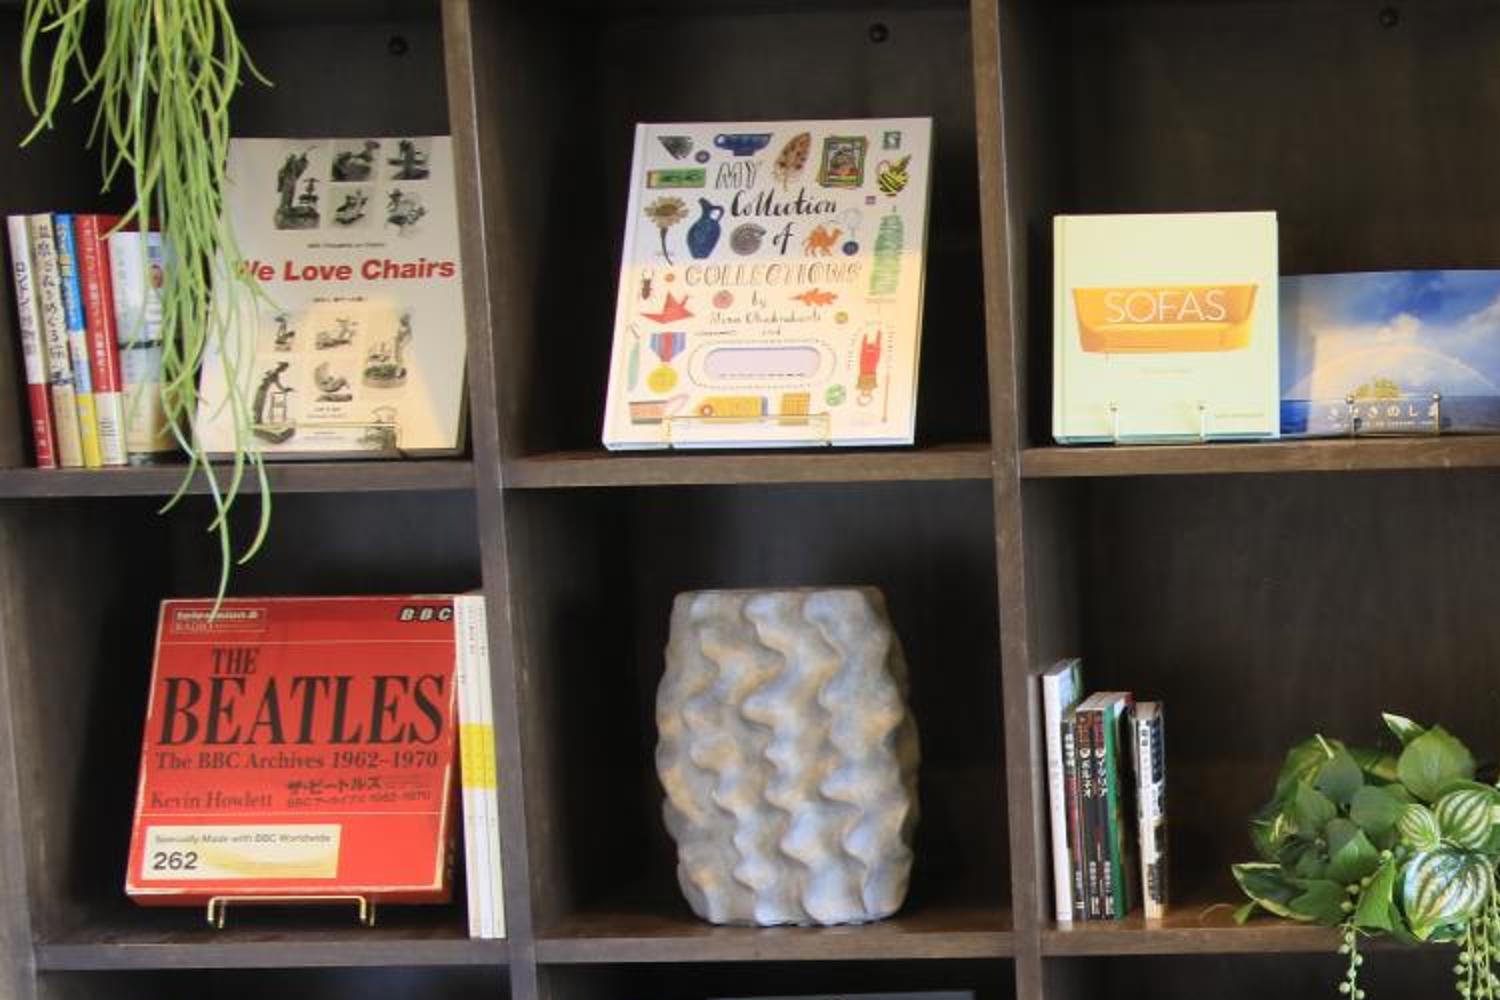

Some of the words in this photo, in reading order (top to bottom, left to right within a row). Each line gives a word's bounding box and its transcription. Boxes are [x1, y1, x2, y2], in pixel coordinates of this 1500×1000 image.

[715, 161, 760, 189] MY
[731, 188, 837, 217] Collection
[772, 222, 794, 254] of
[284, 260, 353, 282] Love
[361, 258, 455, 280] Chairs
[1104, 289, 1228, 323] SOFAS
[211, 648, 258, 675] THE
[156, 673, 445, 746] BEATLES
[156, 751, 192, 769] The
[199, 751, 241, 769] BBC
[250, 751, 324, 769] Archives
[151, 791, 200, 809] Kevin
[153, 851, 198, 870] 262
